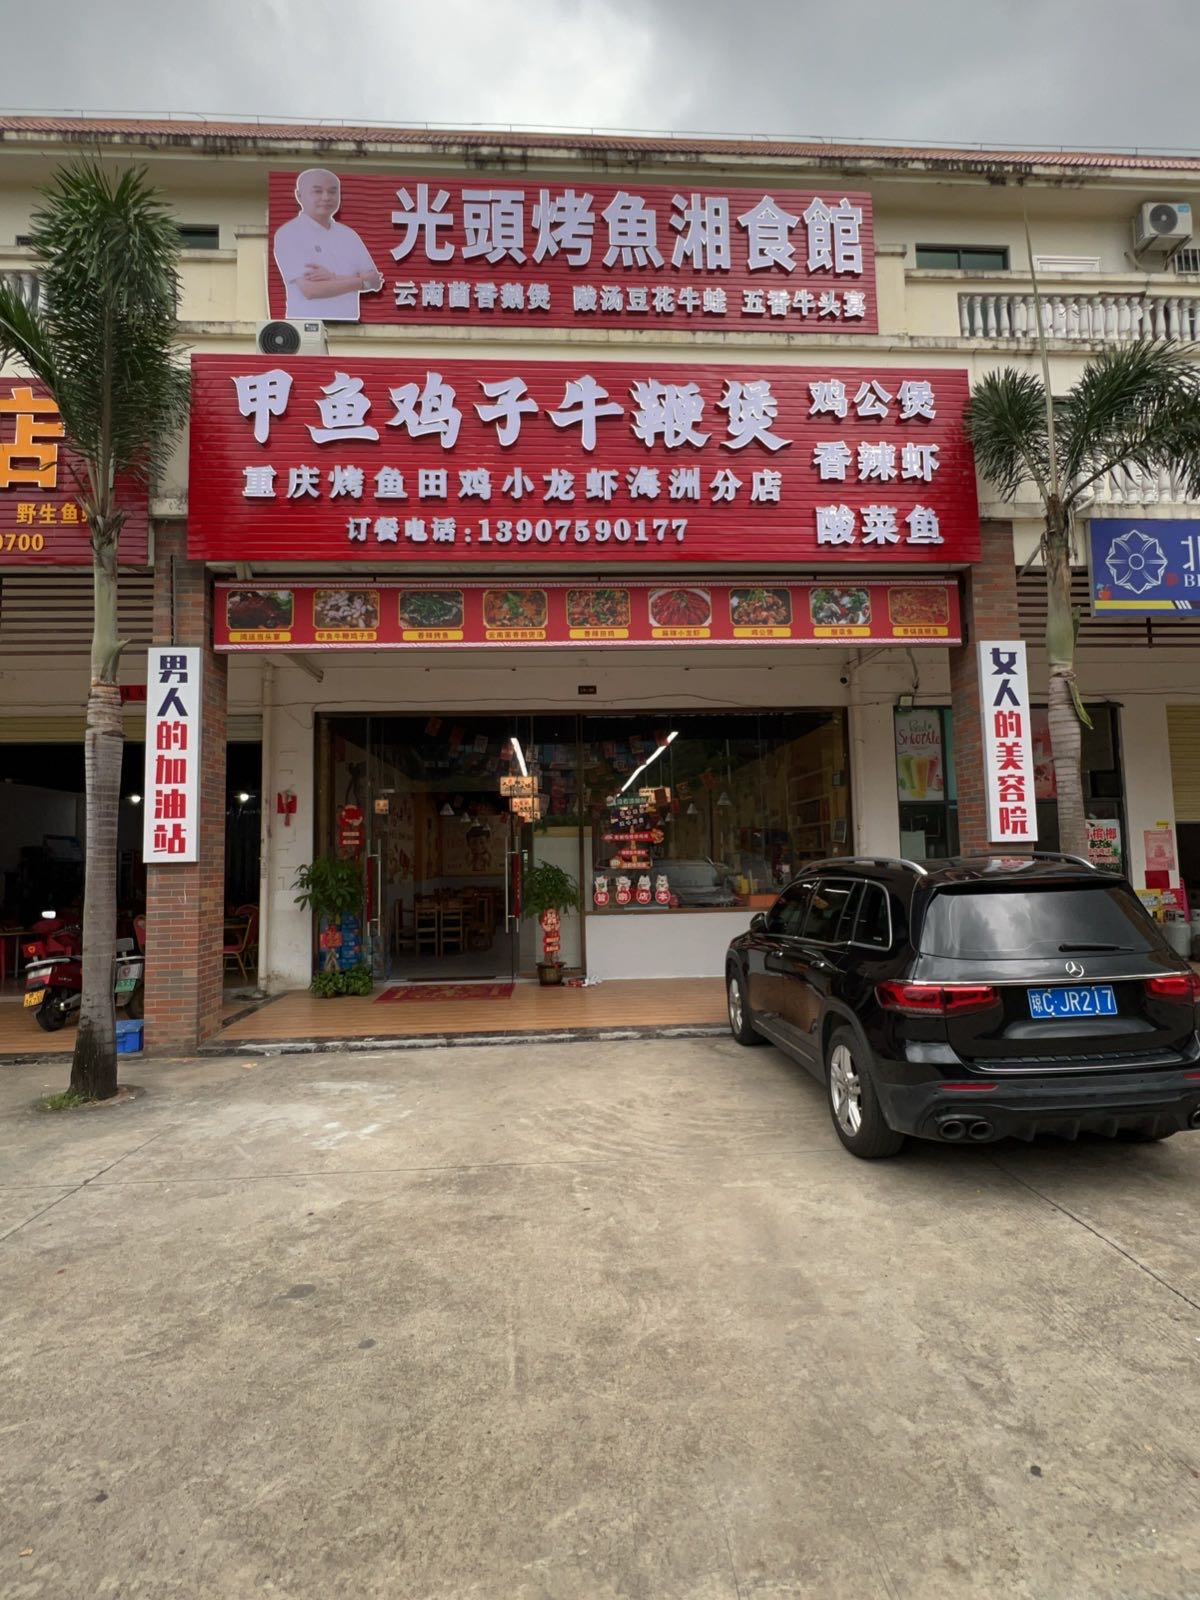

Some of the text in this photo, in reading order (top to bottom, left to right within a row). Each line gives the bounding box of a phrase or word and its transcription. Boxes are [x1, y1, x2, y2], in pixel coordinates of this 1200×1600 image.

[390, 183, 864, 274] 光頭烤魚湘食館
[572, 284, 727, 313] 酸汤豆花牛蛙
[742, 289, 866, 318] 五香牛头宴
[231, 369, 793, 452] 甲鱼鸡子牛鞭煲
[808, 378, 936, 420] 鸡公煲
[813, 440, 940, 482] 香辣虾
[242, 465, 782, 502] 重庆烤鱼田鸡小龙虾海洲分店
[16, 503, 88, 525] 野生鱼
[815, 503, 943, 545] 酸菜鱼
[153, 655, 188, 854] 男人的加油站
[989, 647, 1028, 835] 女人的美容院
[1087, 828, 1116, 840] 槟榔
